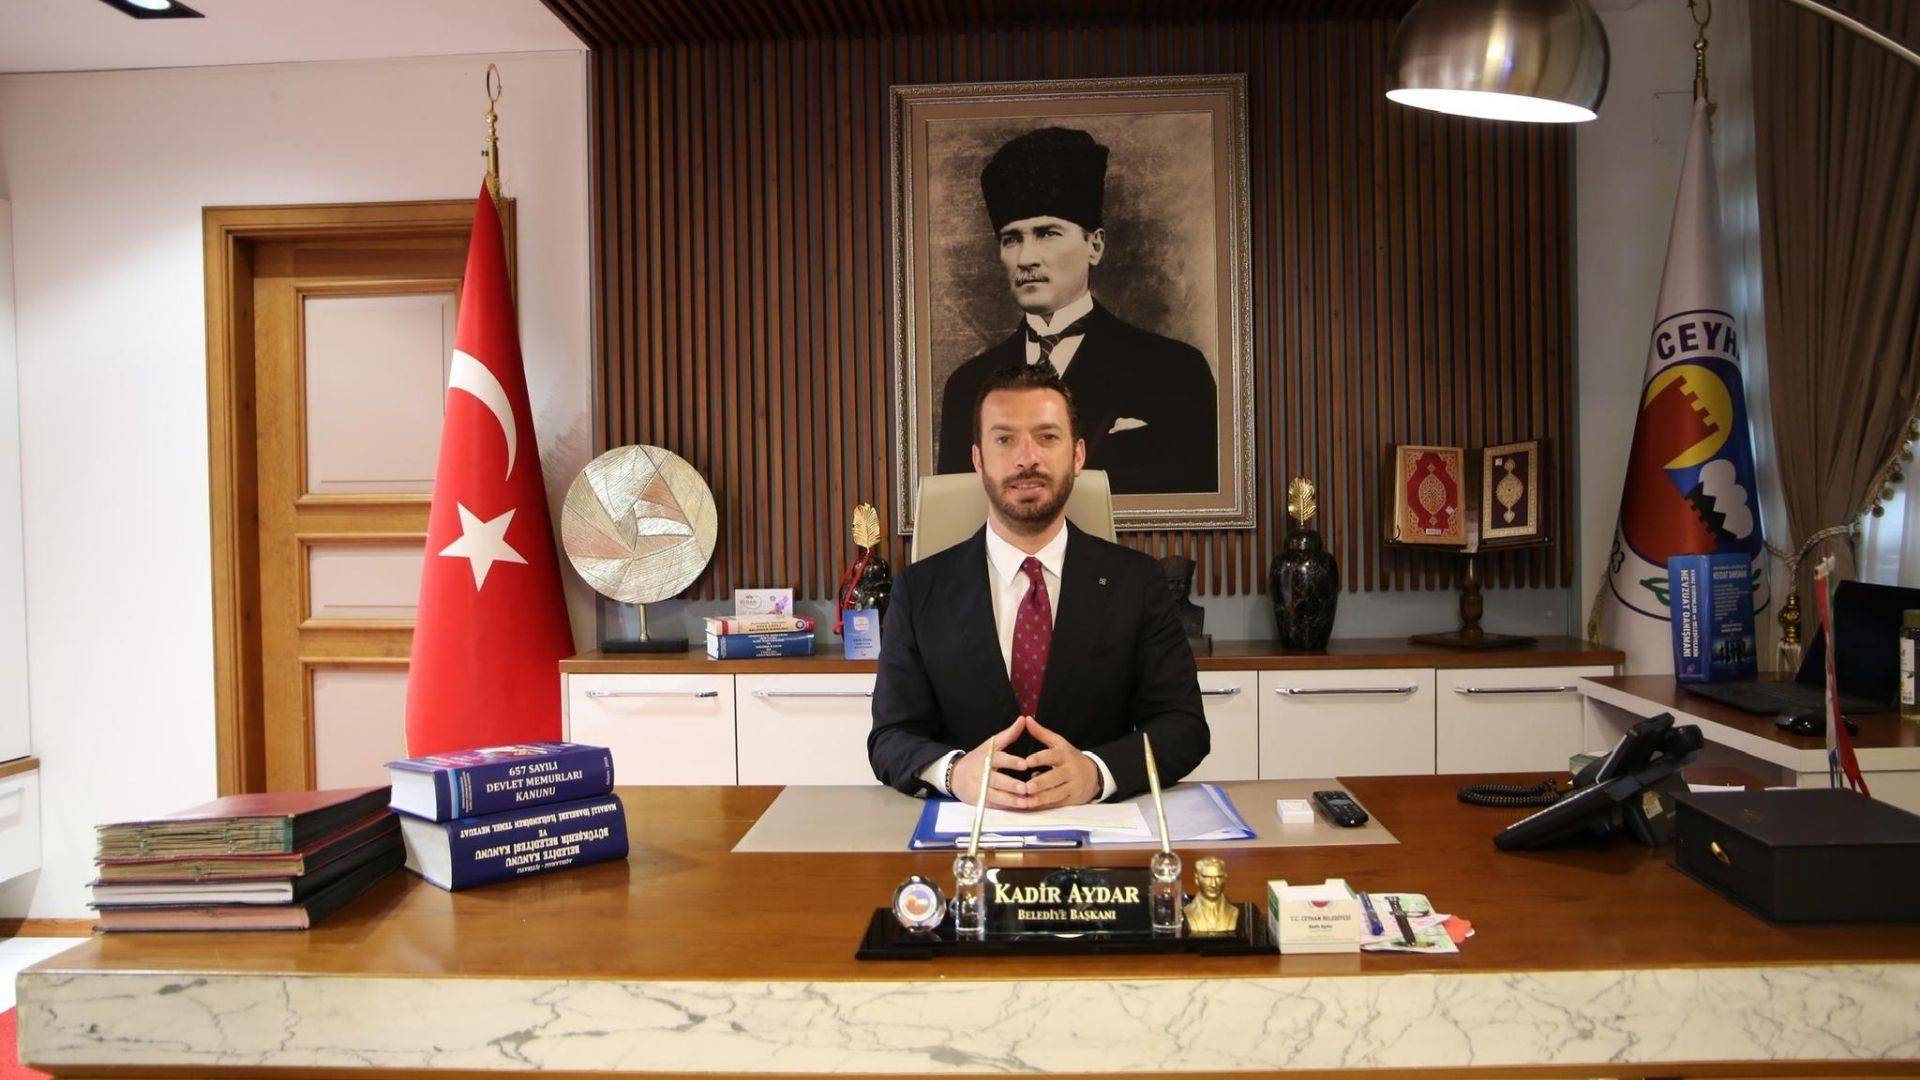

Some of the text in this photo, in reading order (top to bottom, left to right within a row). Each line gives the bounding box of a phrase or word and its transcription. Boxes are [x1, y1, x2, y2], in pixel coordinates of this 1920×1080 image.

[1657, 322, 1739, 360] CEYH
[1681, 570, 1691, 657] MEVZUAT DANIŞMANI
[509, 761, 558, 776] 657 SAYILI
[486, 770, 583, 793] DEVLET MEMURLARI
[516, 787, 556, 802] KANUNU
[460, 826, 491, 838] MEVZUAT
[492, 822, 513, 833] TEMEL
[475, 827, 609, 860] BÜYÜKŞEHİR BELEDİYESİ KANUNU
[506, 844, 580, 867] BELEDİYE KANUNU
[994, 882, 1140, 904] KADİR AYDAR
[1018, 908, 1116, 921] BELEDİYE BAŞKANI
